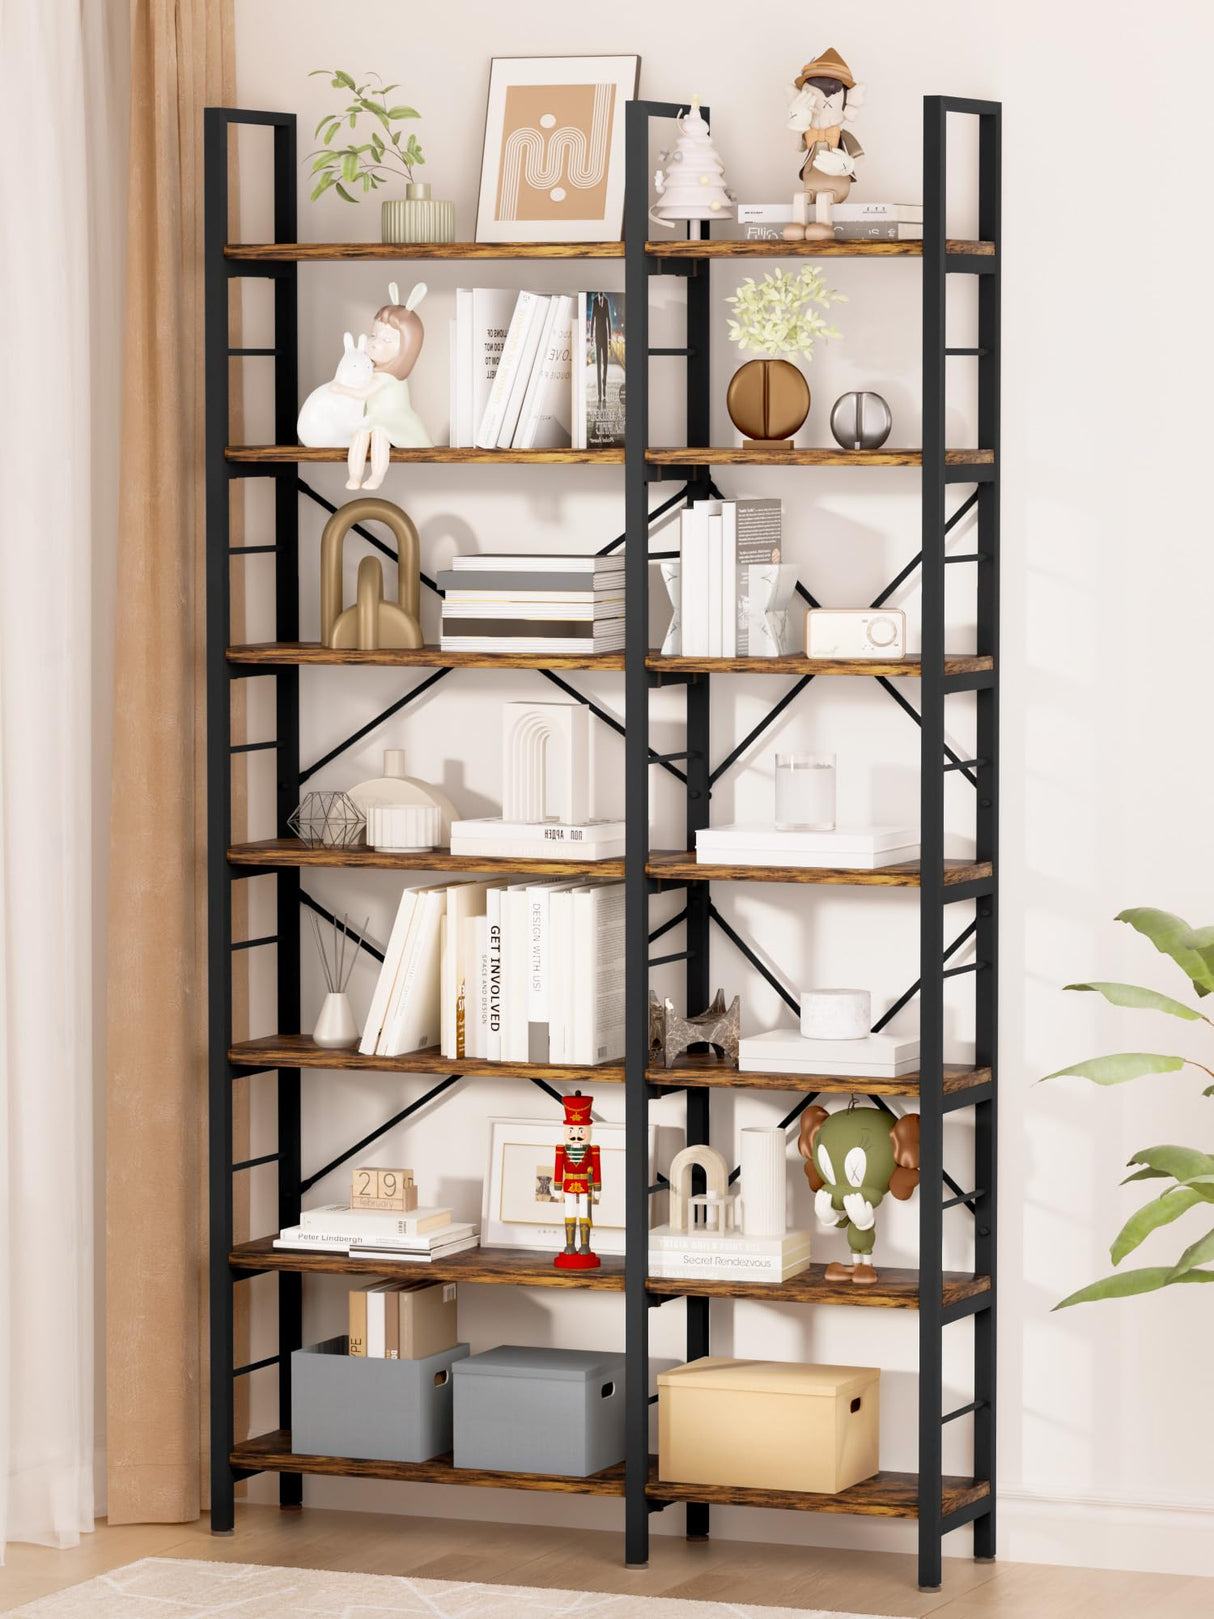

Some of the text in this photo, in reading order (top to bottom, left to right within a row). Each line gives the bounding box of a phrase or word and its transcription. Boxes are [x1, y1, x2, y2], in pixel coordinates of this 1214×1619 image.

[532, 903, 541, 942] DESIGN
[532, 945, 541, 972] WITH
[490, 925, 501, 1032] GET INVOLVED
[321, 1234, 363, 1244] Lindbergh
[683, 1254, 771, 1268] Secret Rendezvous
